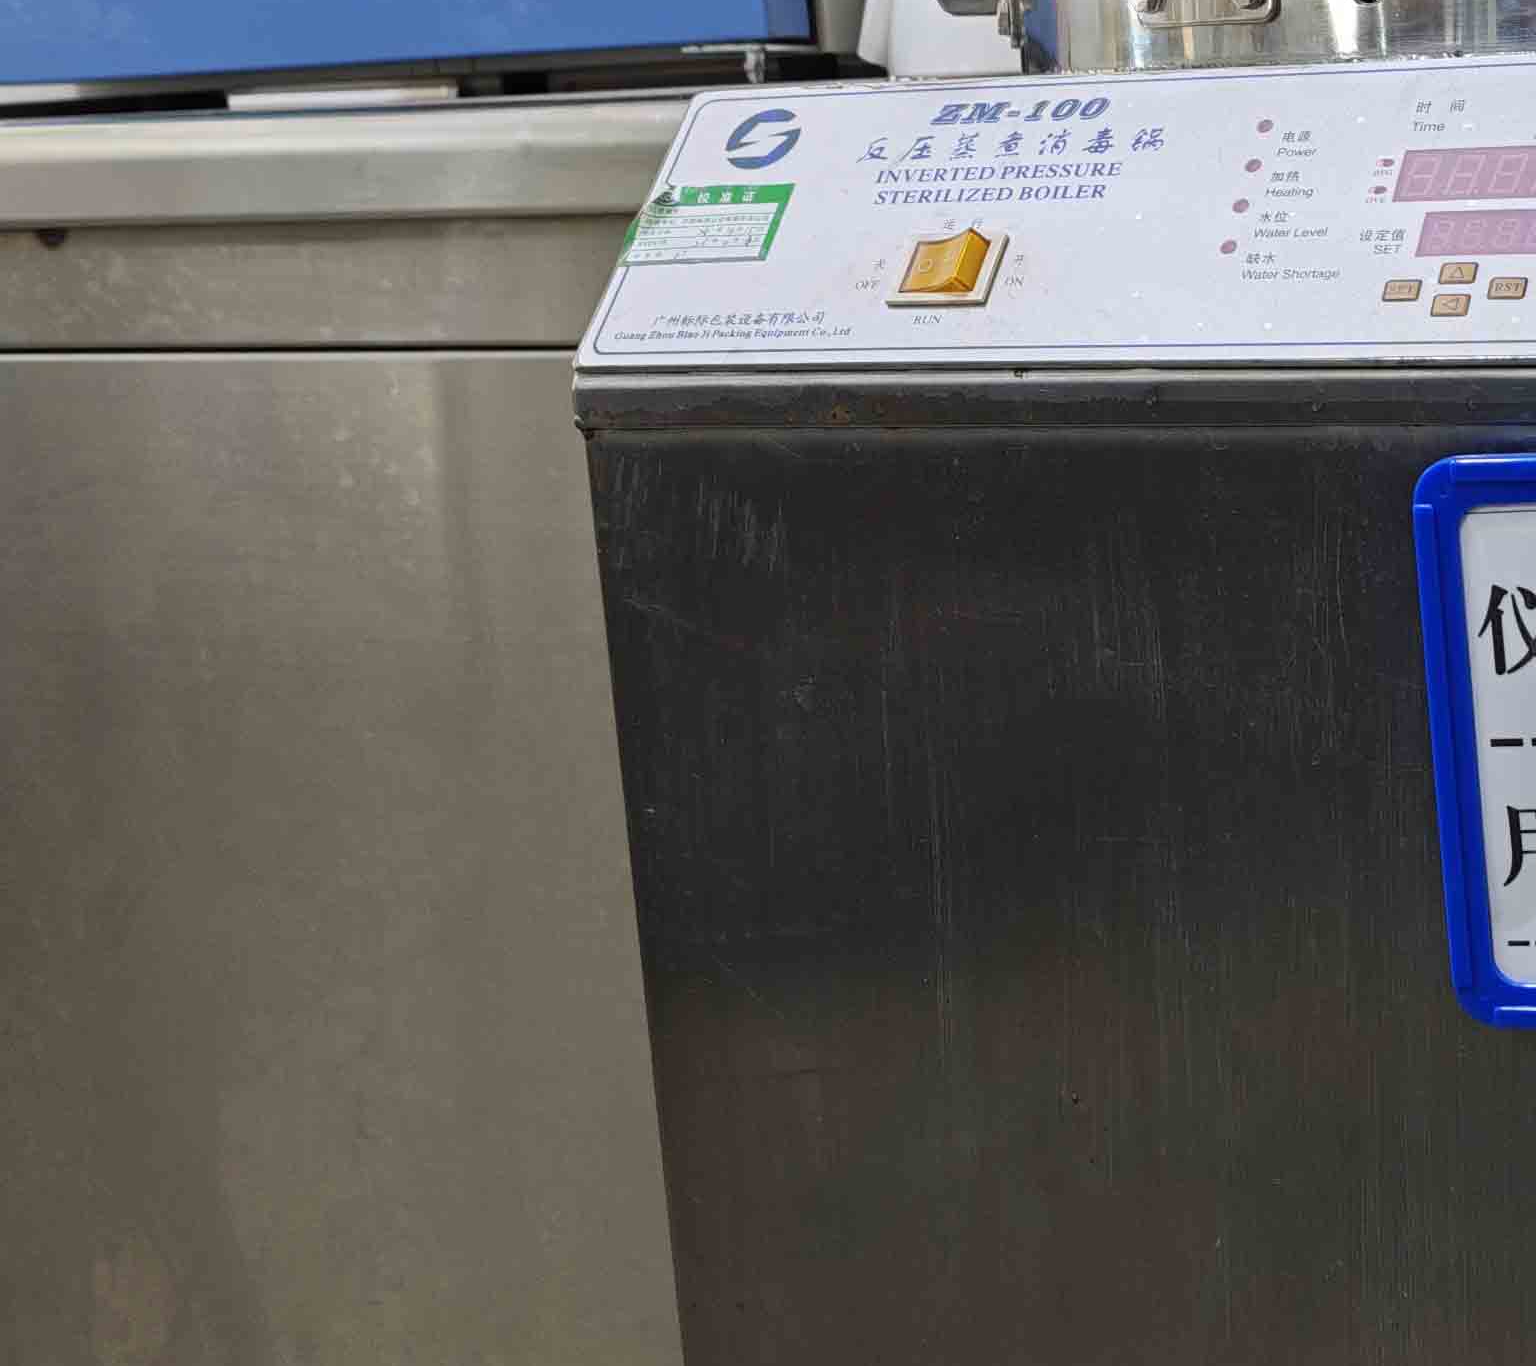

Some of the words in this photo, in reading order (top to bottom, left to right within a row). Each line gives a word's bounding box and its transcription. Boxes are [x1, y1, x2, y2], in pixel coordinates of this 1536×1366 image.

[930, 97, 1112, 125] ZM-100
[1413, 120, 1446, 132] Time
[1281, 130, 1312, 143] 电源
[856, 126, 1166, 164] 反压蒸煮消毒锅
[1276, 146, 1318, 158] Power
[875, 166, 995, 185] INVERTED
[999, 161, 1123, 181] PRESSURE
[874, 187, 1014, 206] STERILIZED
[1018, 184, 1107, 202] BOILER
[1264, 186, 1315, 199] Heating
[1259, 210, 1289, 223] 水位
[1254, 227, 1291, 239] Water
[1293, 226, 1329, 238] Level
[1359, 228, 1406, 242] 设定值
[1373, 244, 1402, 255] SET
[1241, 269, 1280, 281] Water
[1282, 268, 1341, 282] Shortage
[1494, 281, 1523, 293] RST
[913, 314, 944, 325] RUN
[614, 331, 647, 342] Guang
[712, 328, 751, 340] Packing
[753, 328, 810, 340] Equipment
